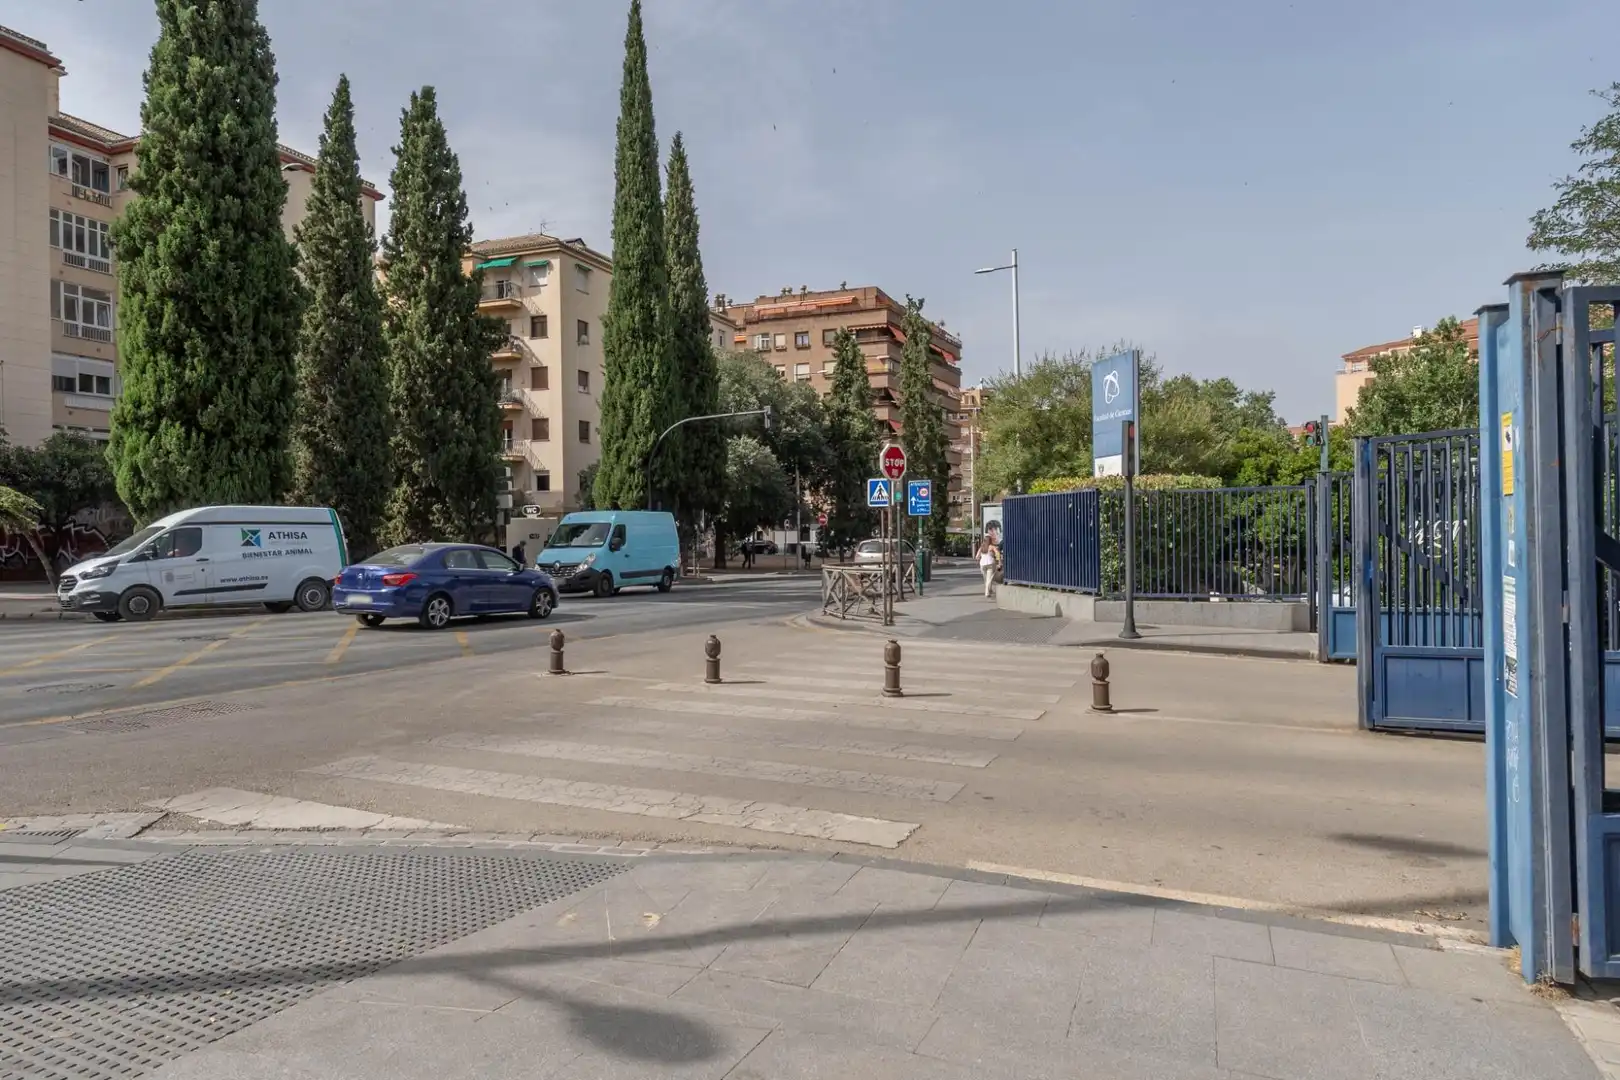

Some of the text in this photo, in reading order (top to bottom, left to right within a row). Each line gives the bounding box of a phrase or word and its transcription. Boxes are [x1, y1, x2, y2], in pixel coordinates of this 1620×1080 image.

[885, 458, 904, 467] STOP
[268, 531, 308, 540] ATHISA
[242, 548, 312, 560] BIENESTAR ANIMAL
